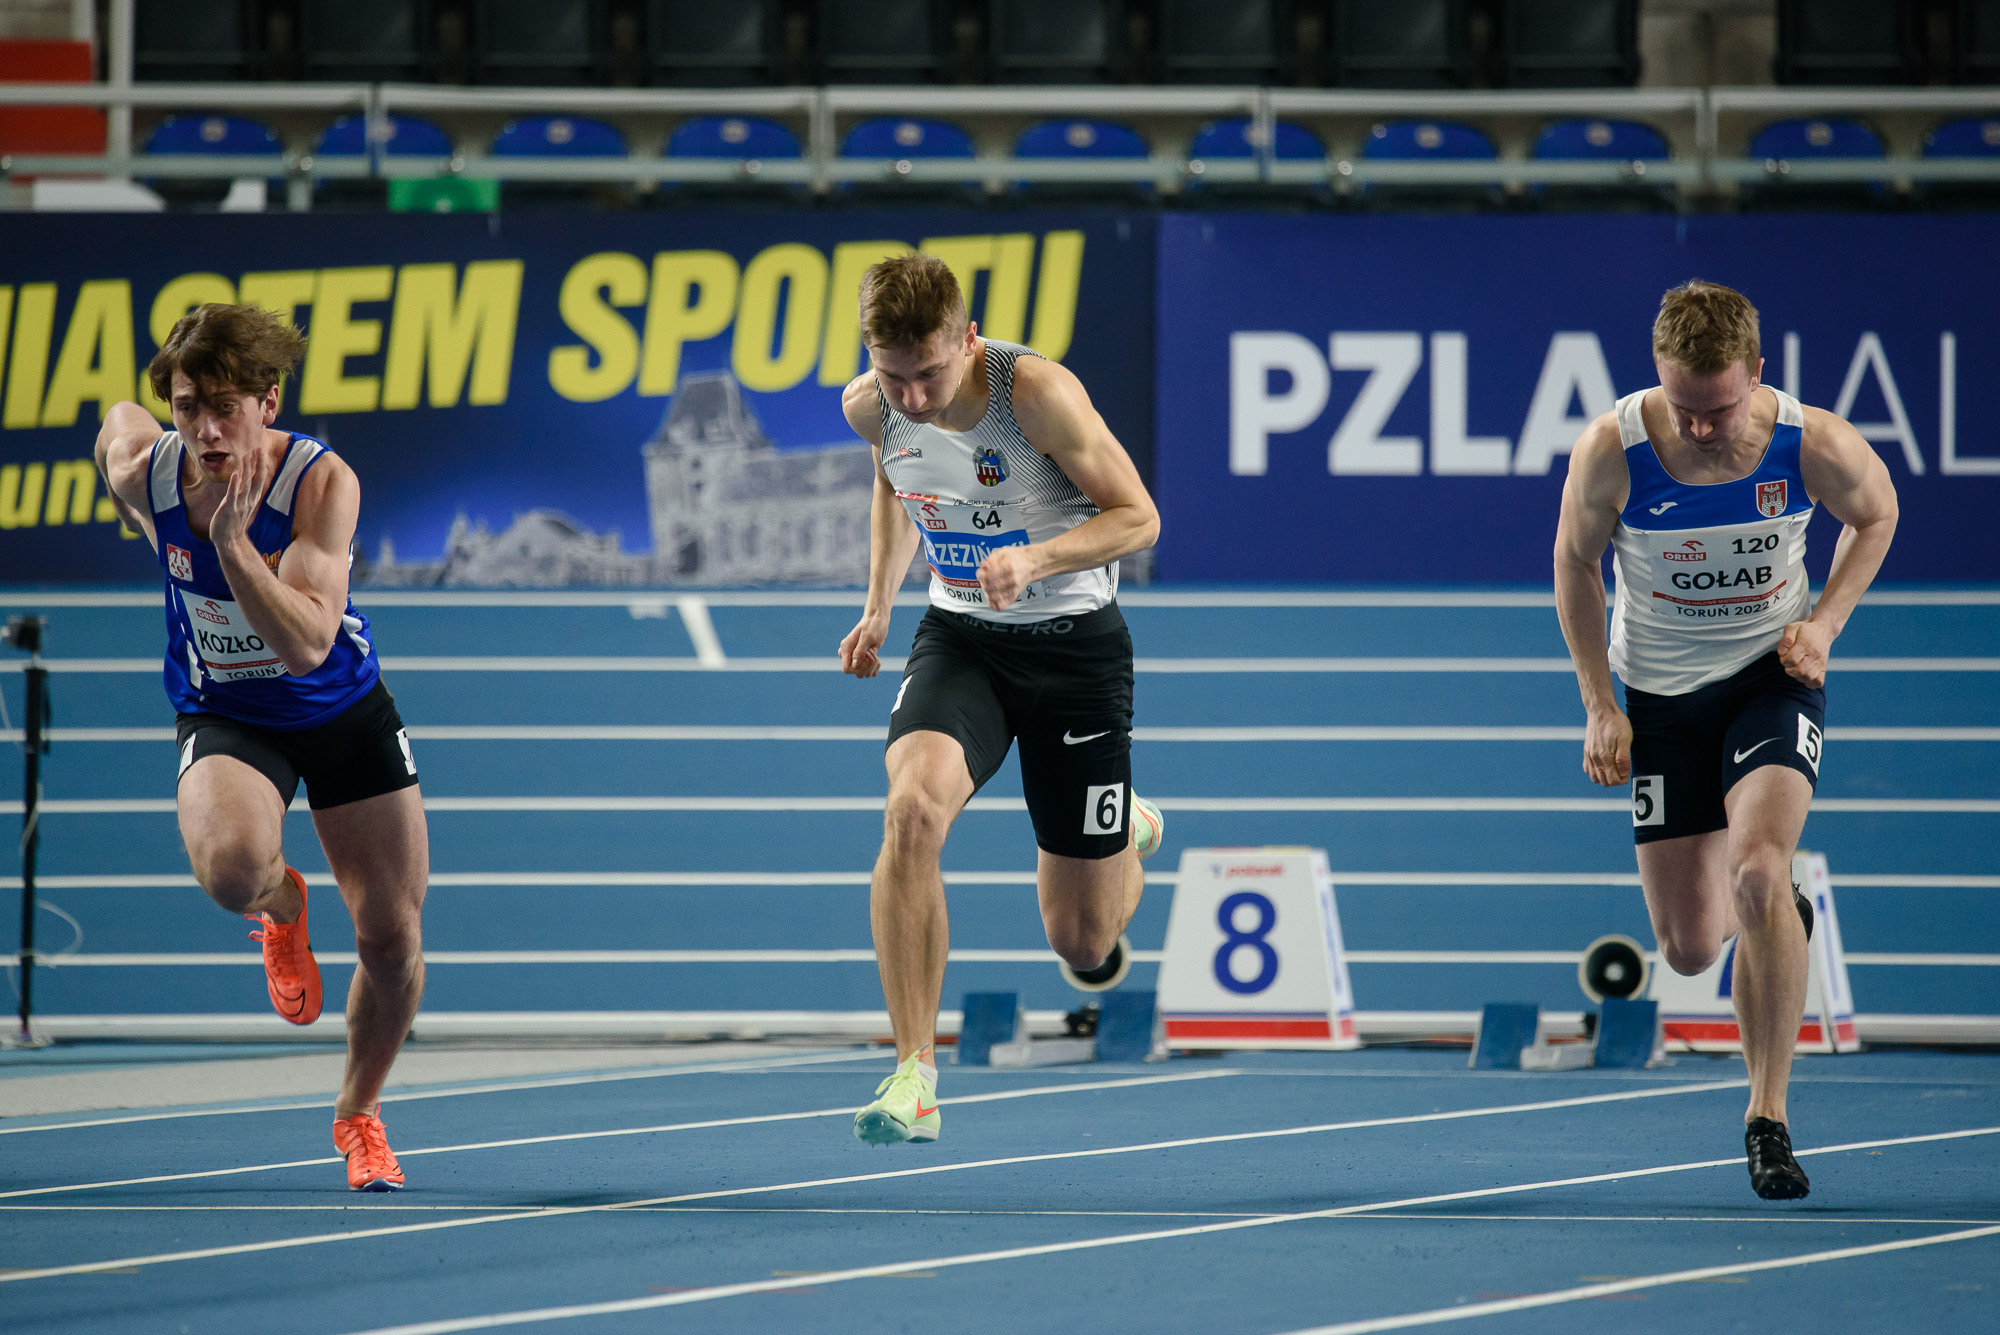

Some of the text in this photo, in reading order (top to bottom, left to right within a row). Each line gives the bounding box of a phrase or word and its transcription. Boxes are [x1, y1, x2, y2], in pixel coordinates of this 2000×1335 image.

[0, 231, 1086, 428] IASTEM SPORTU
[1229, 332, 1617, 476] PZLA
[972, 510, 1002, 530] 64
[1732, 534, 1779, 555] 120
[1664, 552, 1705, 561] ORLEN
[1671, 565, 1773, 590] GOŁĄB
[943, 585, 983, 603] TORUŃ
[197, 609, 228, 625] ORLEN
[1676, 601, 1769, 618] TORUŃ 2022
[1012, 619, 1074, 635] PRO
[226, 665, 278, 680] TORUŃ
[1804, 723, 1821, 764] 5
[1095, 788, 1117, 830] 6
[1635, 780, 1654, 821] 5
[1214, 891, 1280, 995] 8
